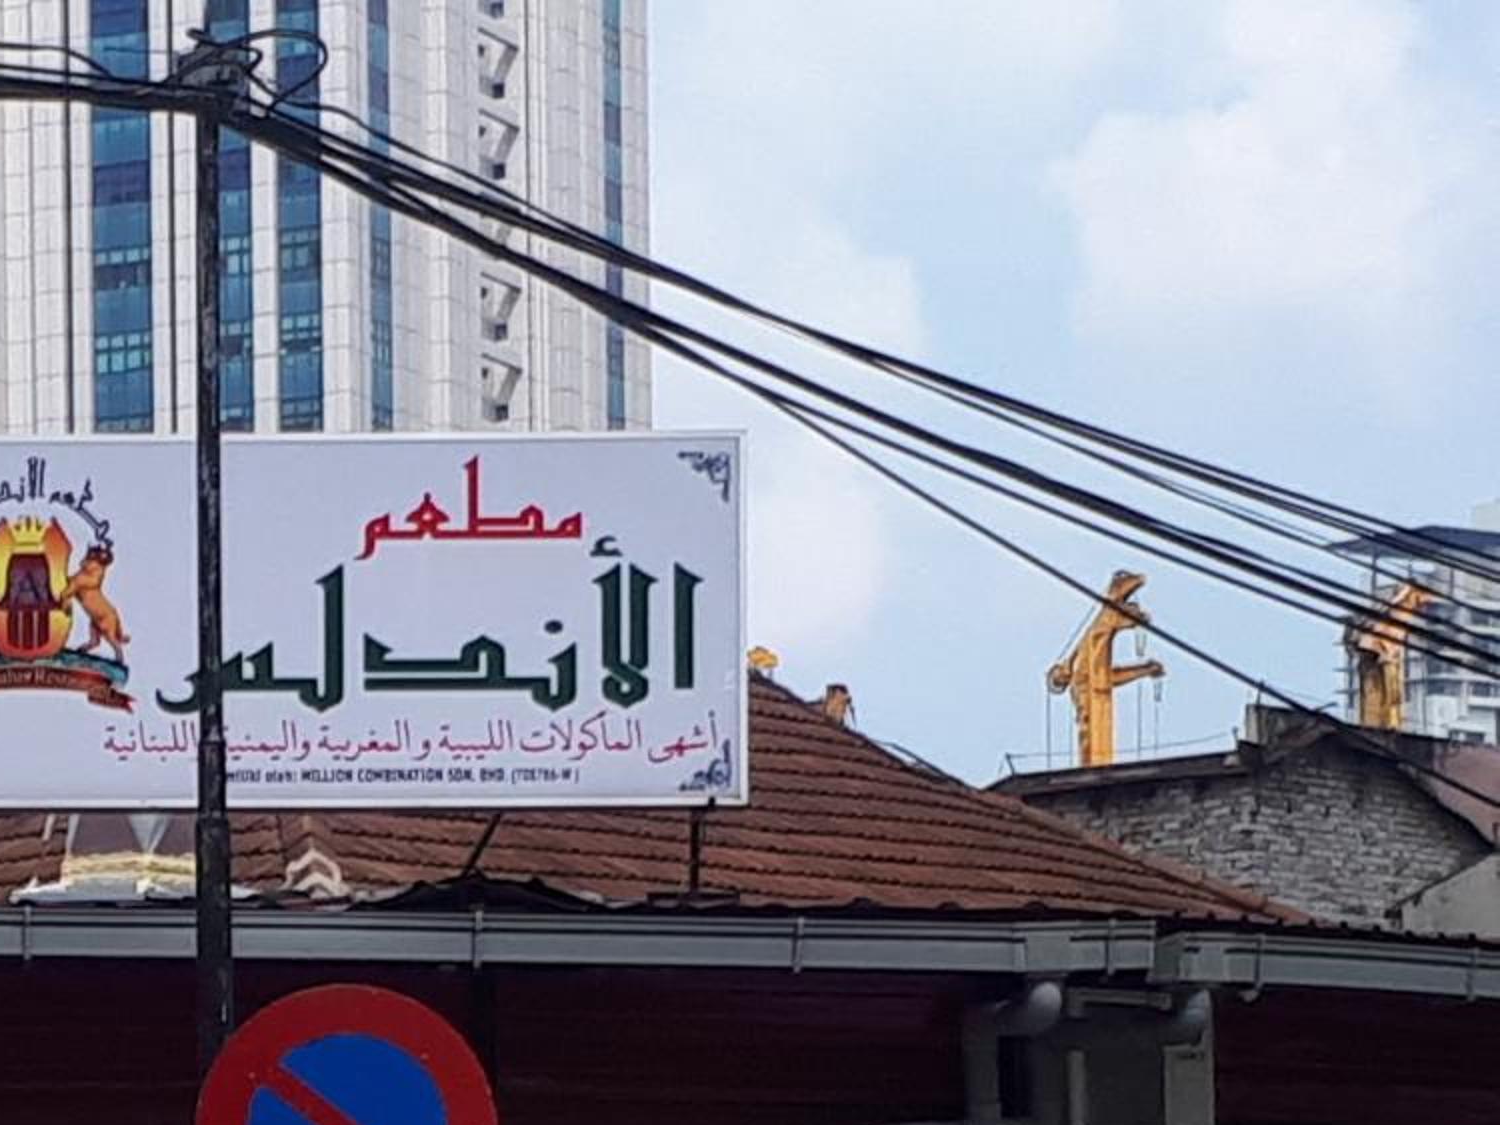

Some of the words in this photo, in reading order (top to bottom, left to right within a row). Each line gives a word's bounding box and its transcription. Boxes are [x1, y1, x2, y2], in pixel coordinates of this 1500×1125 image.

[354, 455, 582, 561] مطعم
[156, 535, 704, 714] الأندلس
[103, 719, 200, 762] اللبنانية
[225, 719, 310, 762] واليمني
[316, 719, 411, 761] المغربية
[438, 719, 513, 760] الليبية
[649, 710, 717, 762] أشهى
[357, 768, 444, 783] COMBINATION
